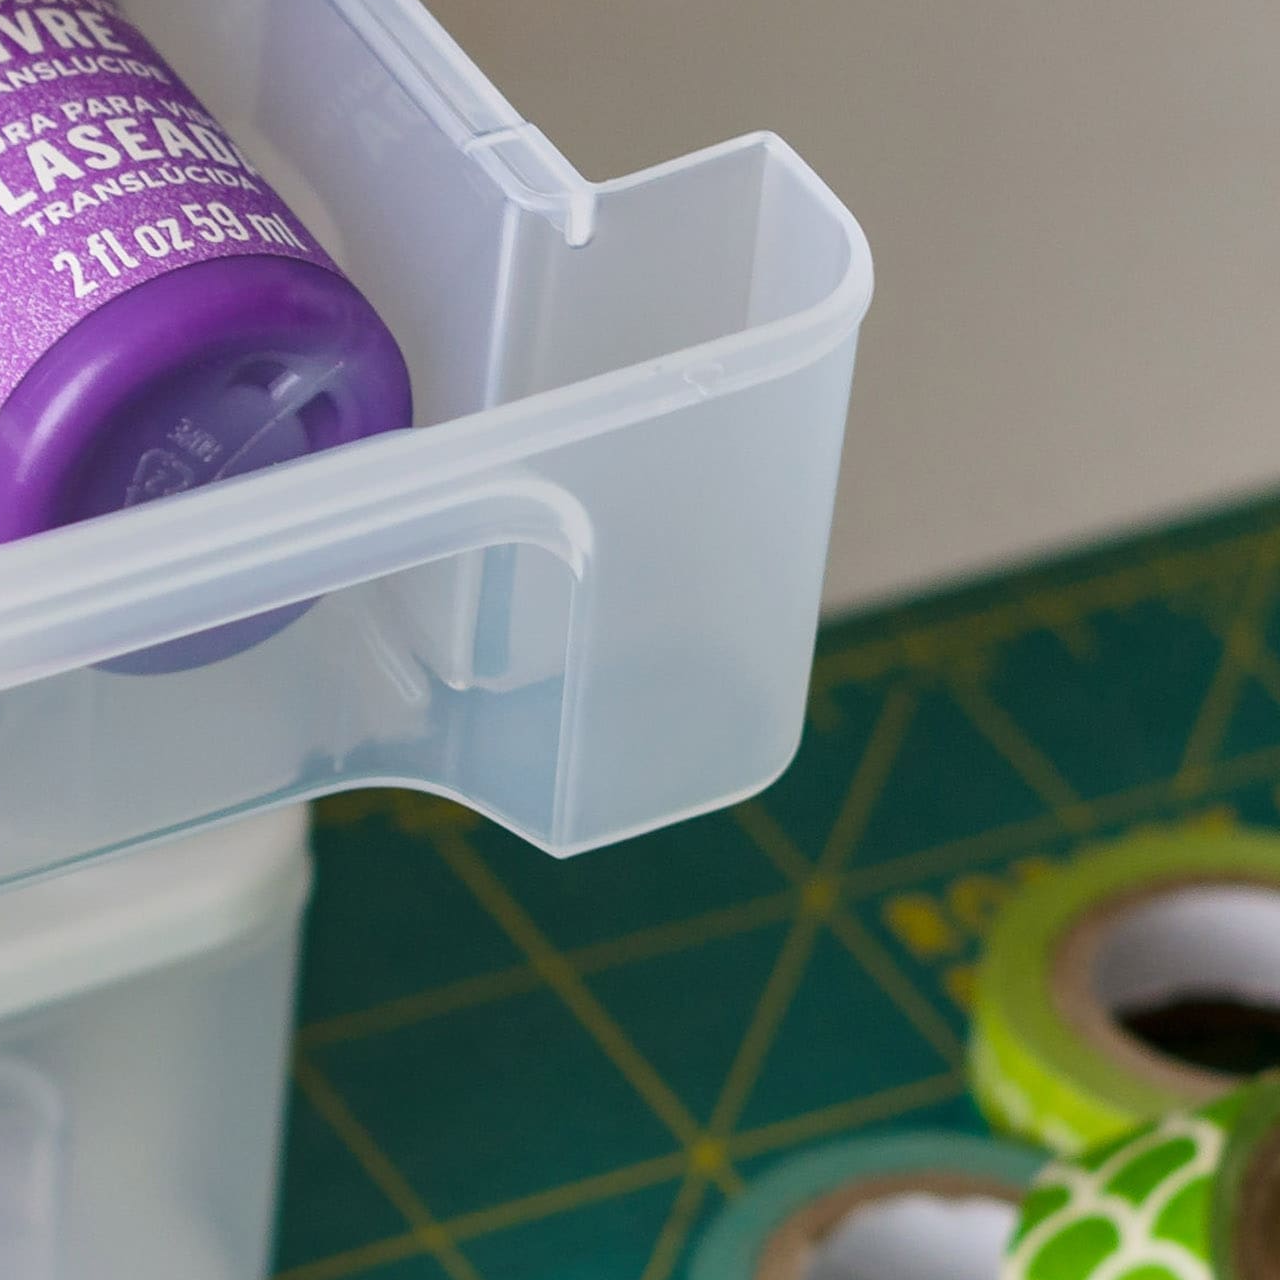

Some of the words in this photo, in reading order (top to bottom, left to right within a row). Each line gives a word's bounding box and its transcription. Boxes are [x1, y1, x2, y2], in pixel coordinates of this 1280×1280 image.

[60, 94, 157, 122] PARA
[51, 250, 99, 299] 2
[87, 228, 141, 279] fl
[135, 216, 196, 259] oz
[180, 201, 251, 245] 59
[245, 211, 309, 253] ml
